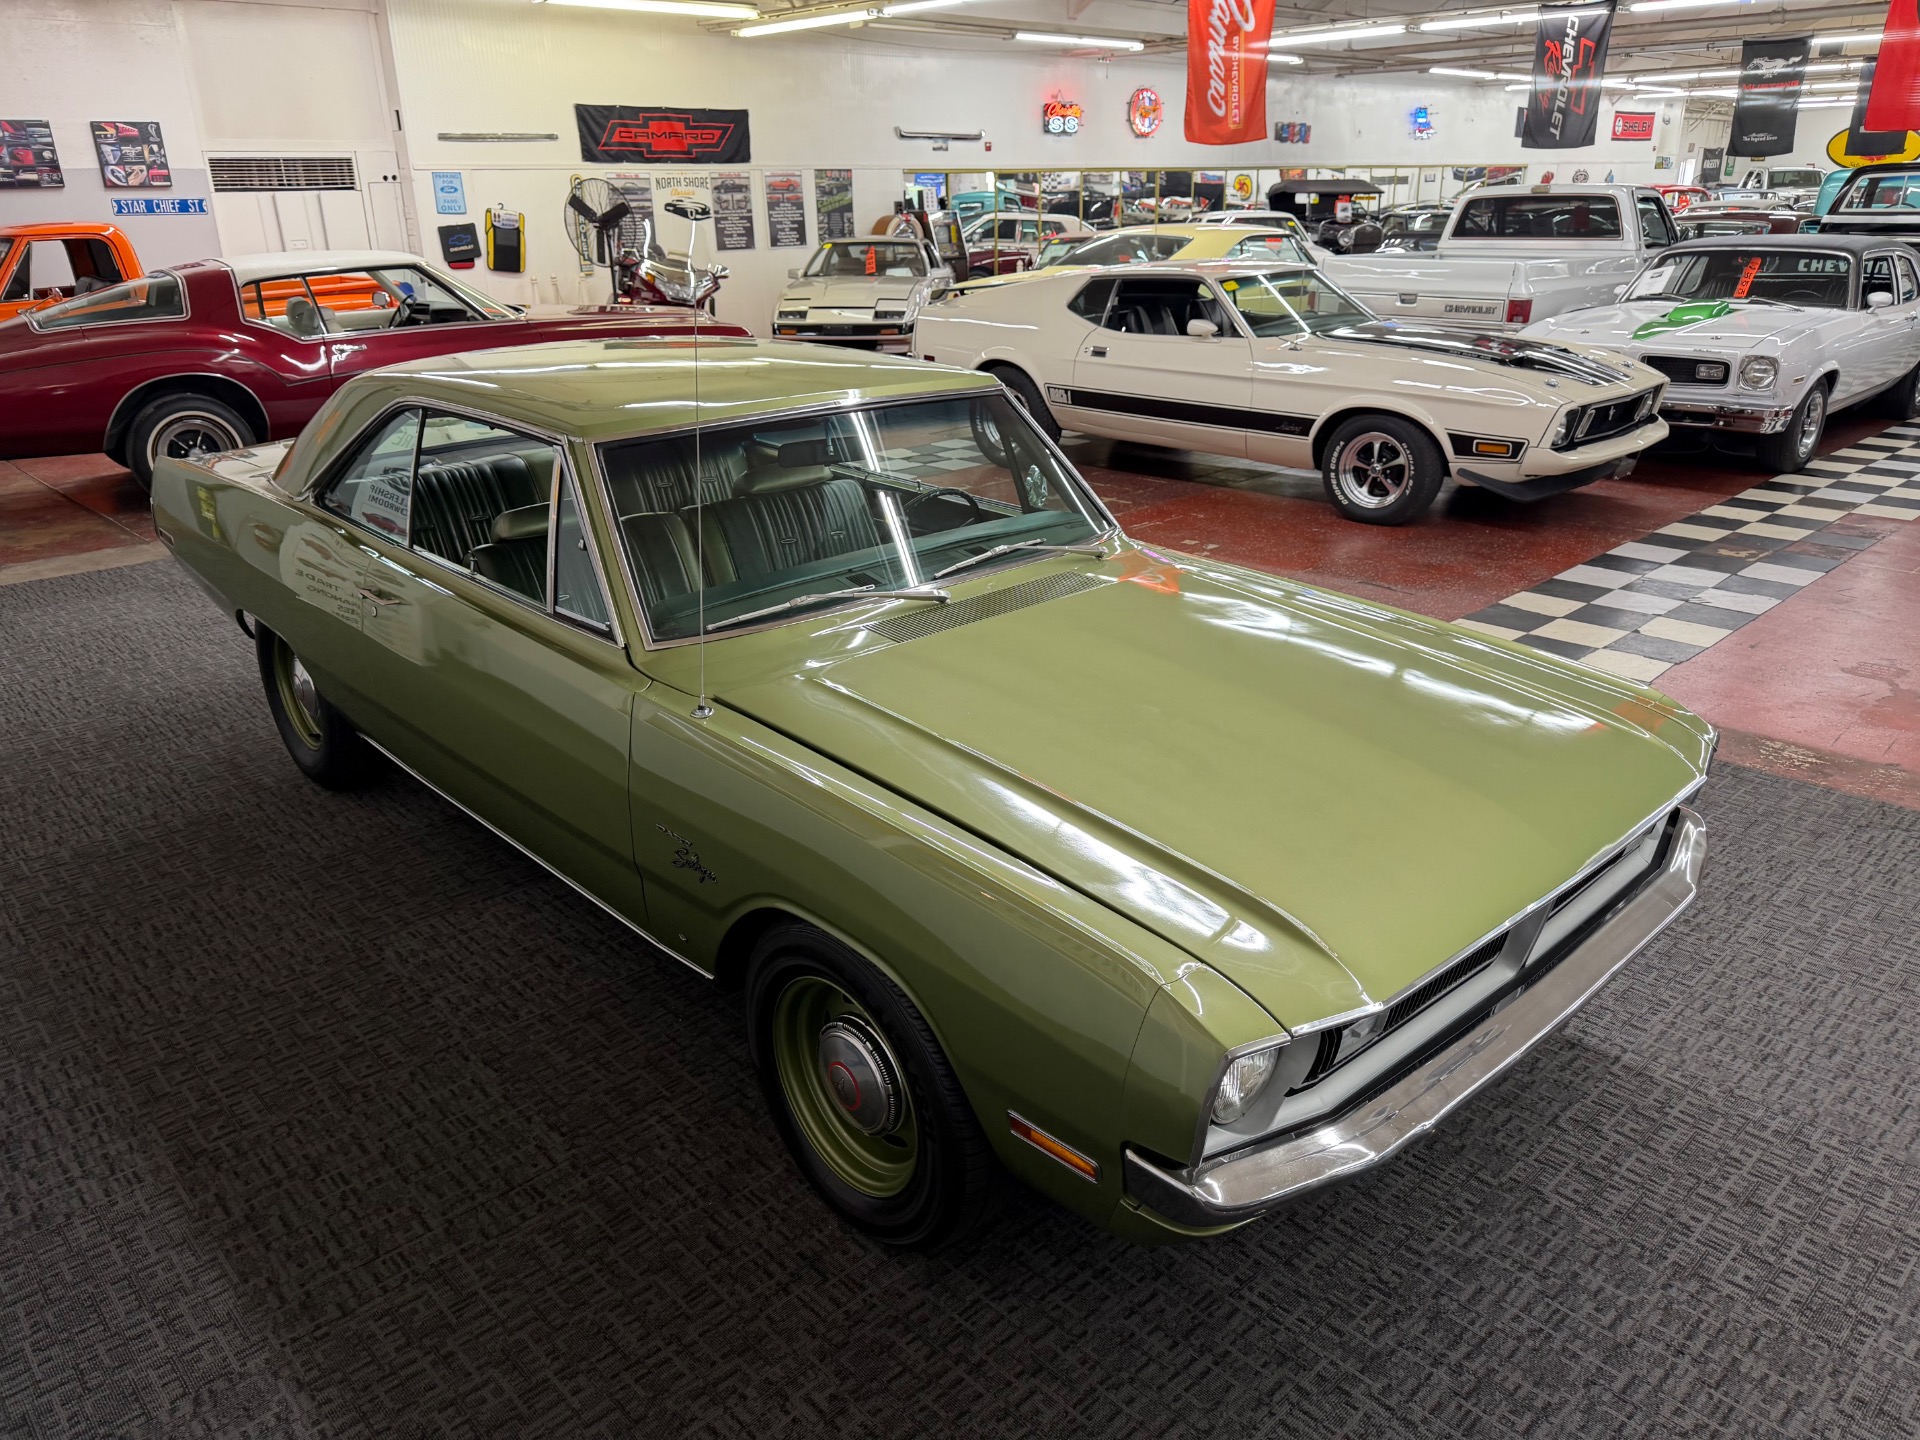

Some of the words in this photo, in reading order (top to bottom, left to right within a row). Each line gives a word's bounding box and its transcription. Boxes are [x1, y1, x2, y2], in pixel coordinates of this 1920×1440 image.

[1537, 39, 1562, 117] Rang
[1549, 14, 1579, 141] CHEVROLET
[1231, 53, 1240, 124] CHEVROLET
[1049, 116, 1079, 133] SS
[1623, 121, 1652, 132] SHELBY
[618, 130, 716, 141] CAMARO
[655, 177, 682, 191] NORTH
[684, 176, 710, 190] SHORE
[120, 200, 147, 213] STAR
[152, 200, 180, 213] CHIEF
[188, 200, 199, 213] ST
[1444, 304, 1498, 314] CHEVROLET
